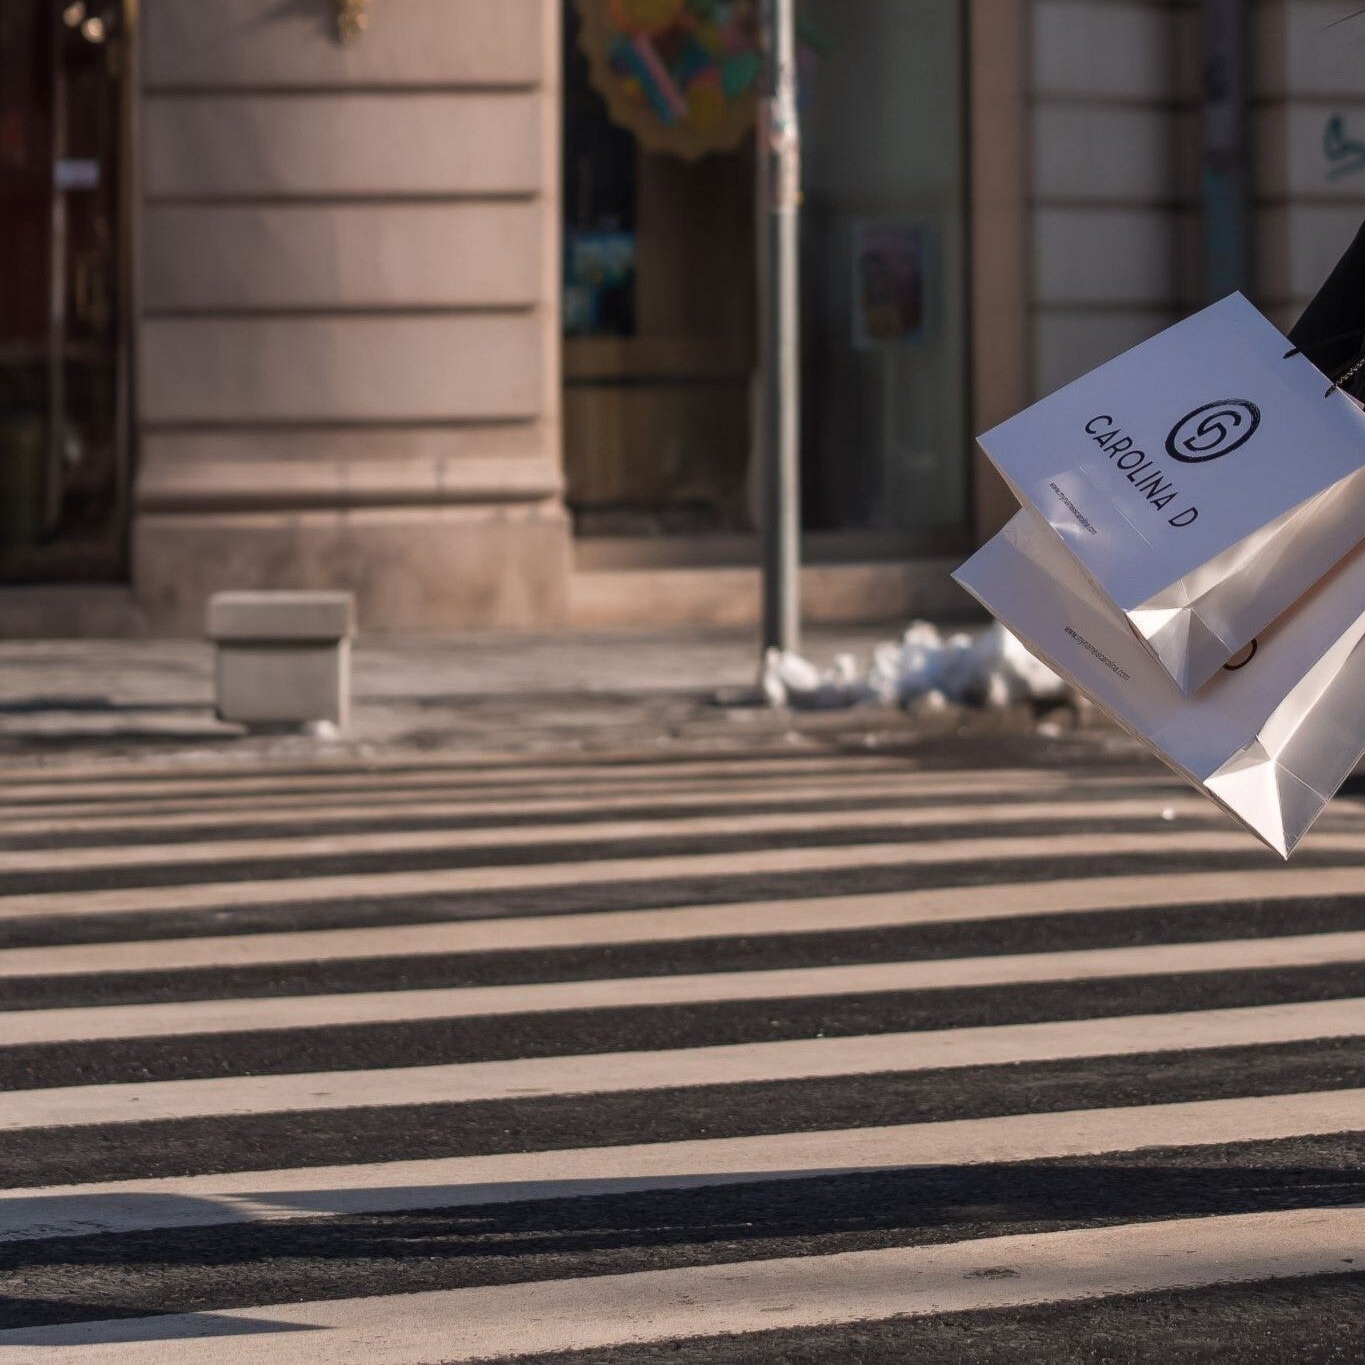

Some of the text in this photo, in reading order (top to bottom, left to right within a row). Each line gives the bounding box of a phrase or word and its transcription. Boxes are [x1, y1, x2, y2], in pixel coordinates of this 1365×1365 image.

[1084, 415, 1199, 527] CAROLINA D
[1063, 626, 1131, 682] www.mynameiscarolina.com
